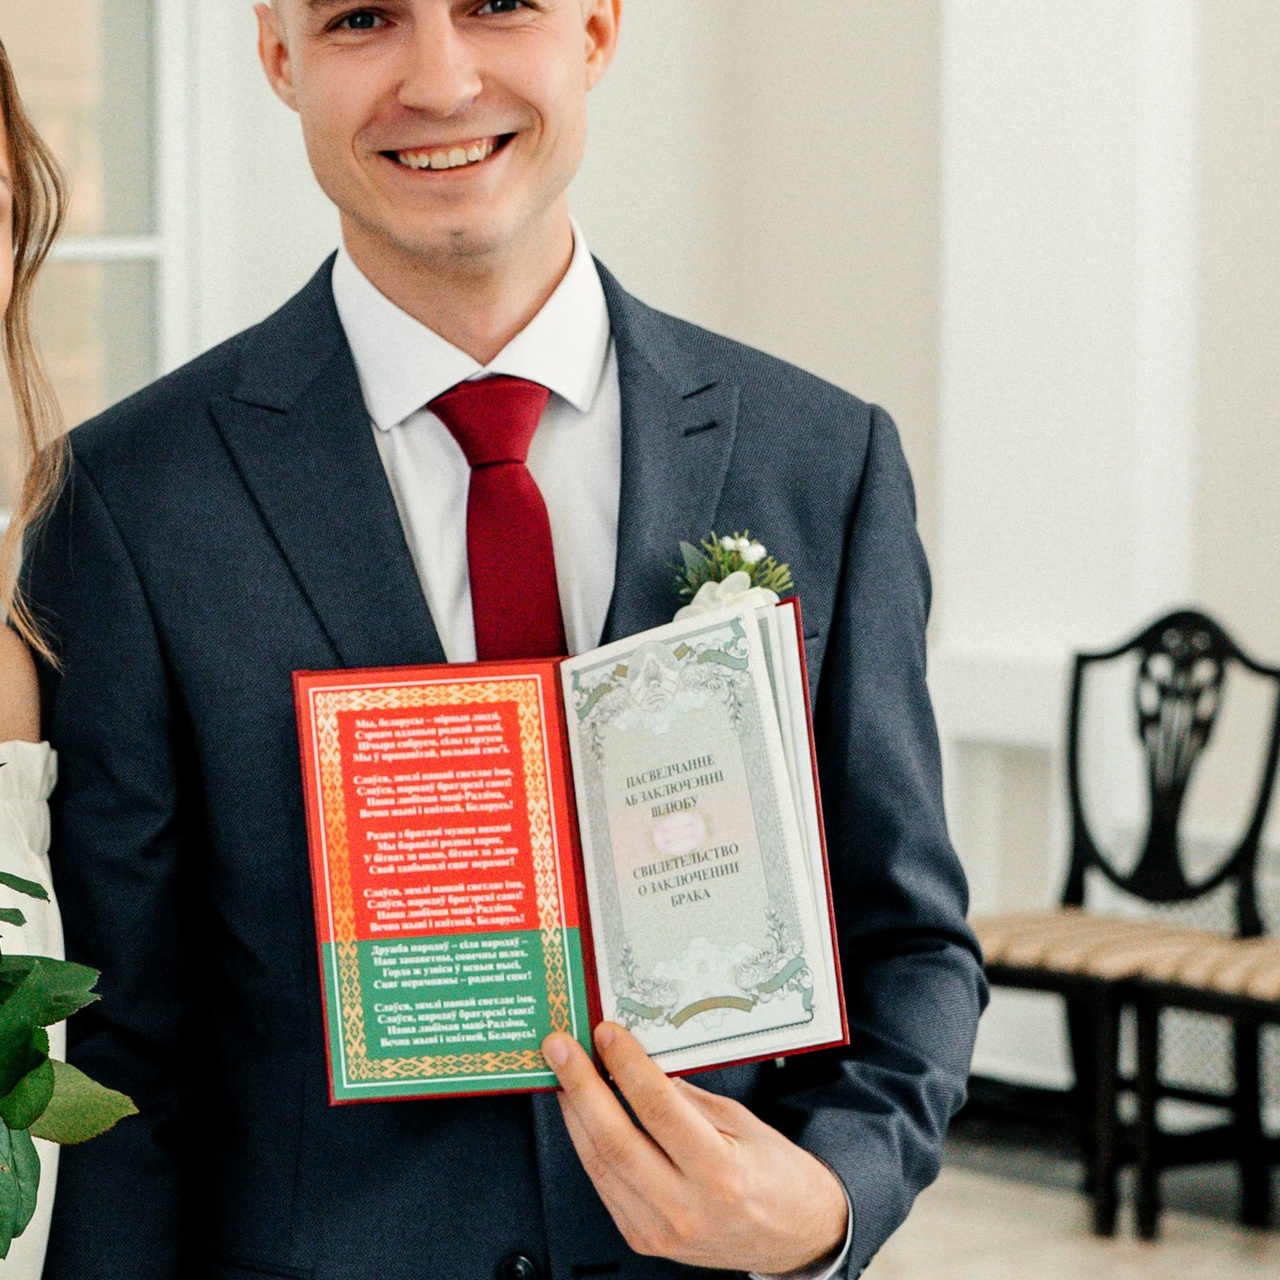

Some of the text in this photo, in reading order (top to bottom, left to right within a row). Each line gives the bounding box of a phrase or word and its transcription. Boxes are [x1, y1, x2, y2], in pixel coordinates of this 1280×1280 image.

[626, 753, 715, 788] ПАСВЕДЧАННЕ
[625, 771, 724, 807] АБ ЗАКЛЮЧЭННІ
[651, 795, 698, 818] ШЛЮБУ
[633, 843, 739, 879] СВИДЕТЕЛЬСТВО
[638, 862, 740, 896] О ЗАКЛЮЧЕНИИ
[671, 889, 711, 907] БРАКА
